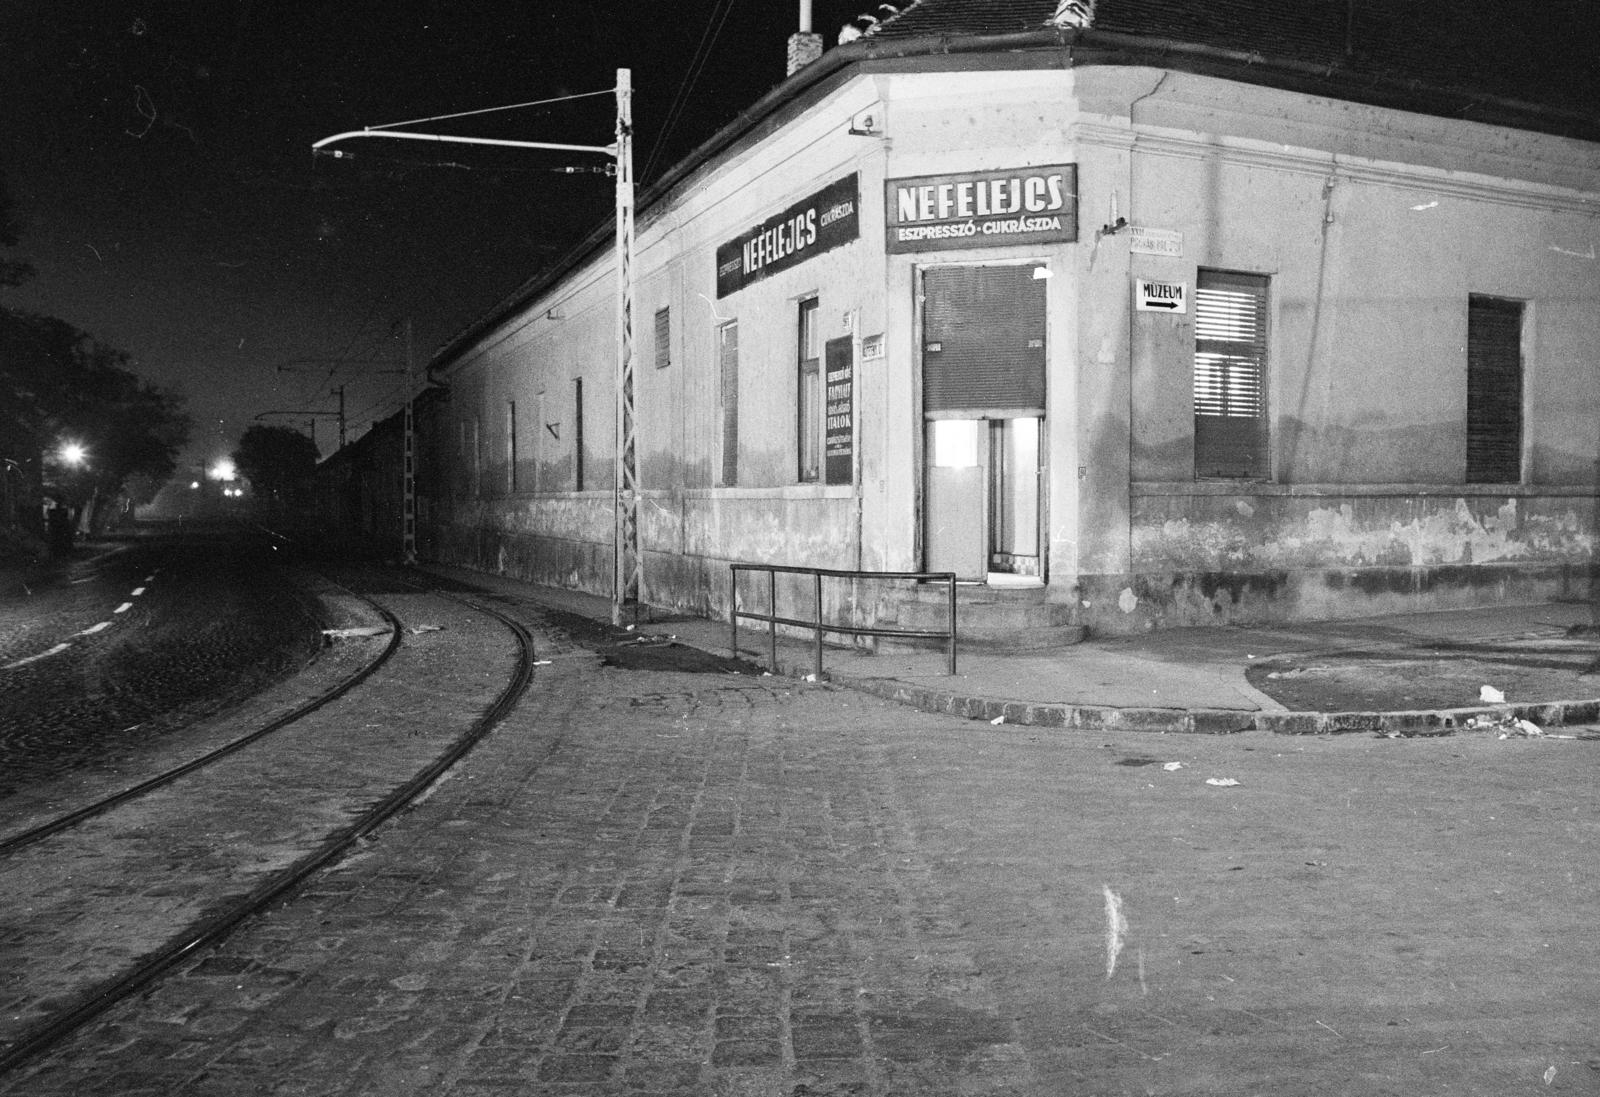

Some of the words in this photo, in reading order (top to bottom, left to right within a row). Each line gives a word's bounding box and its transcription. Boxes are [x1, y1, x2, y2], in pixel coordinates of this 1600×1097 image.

[898, 174, 1063, 222] NEFELEJCS
[743, 208, 817, 275] NEFELEJCS
[898, 220, 976, 242] ESZPRESSZÓ
[982, 215, 1062, 235] CUKRÁSZDA
[1143, 281, 1182, 300] MÚZEUM
[828, 413, 851, 430] ITALOK
